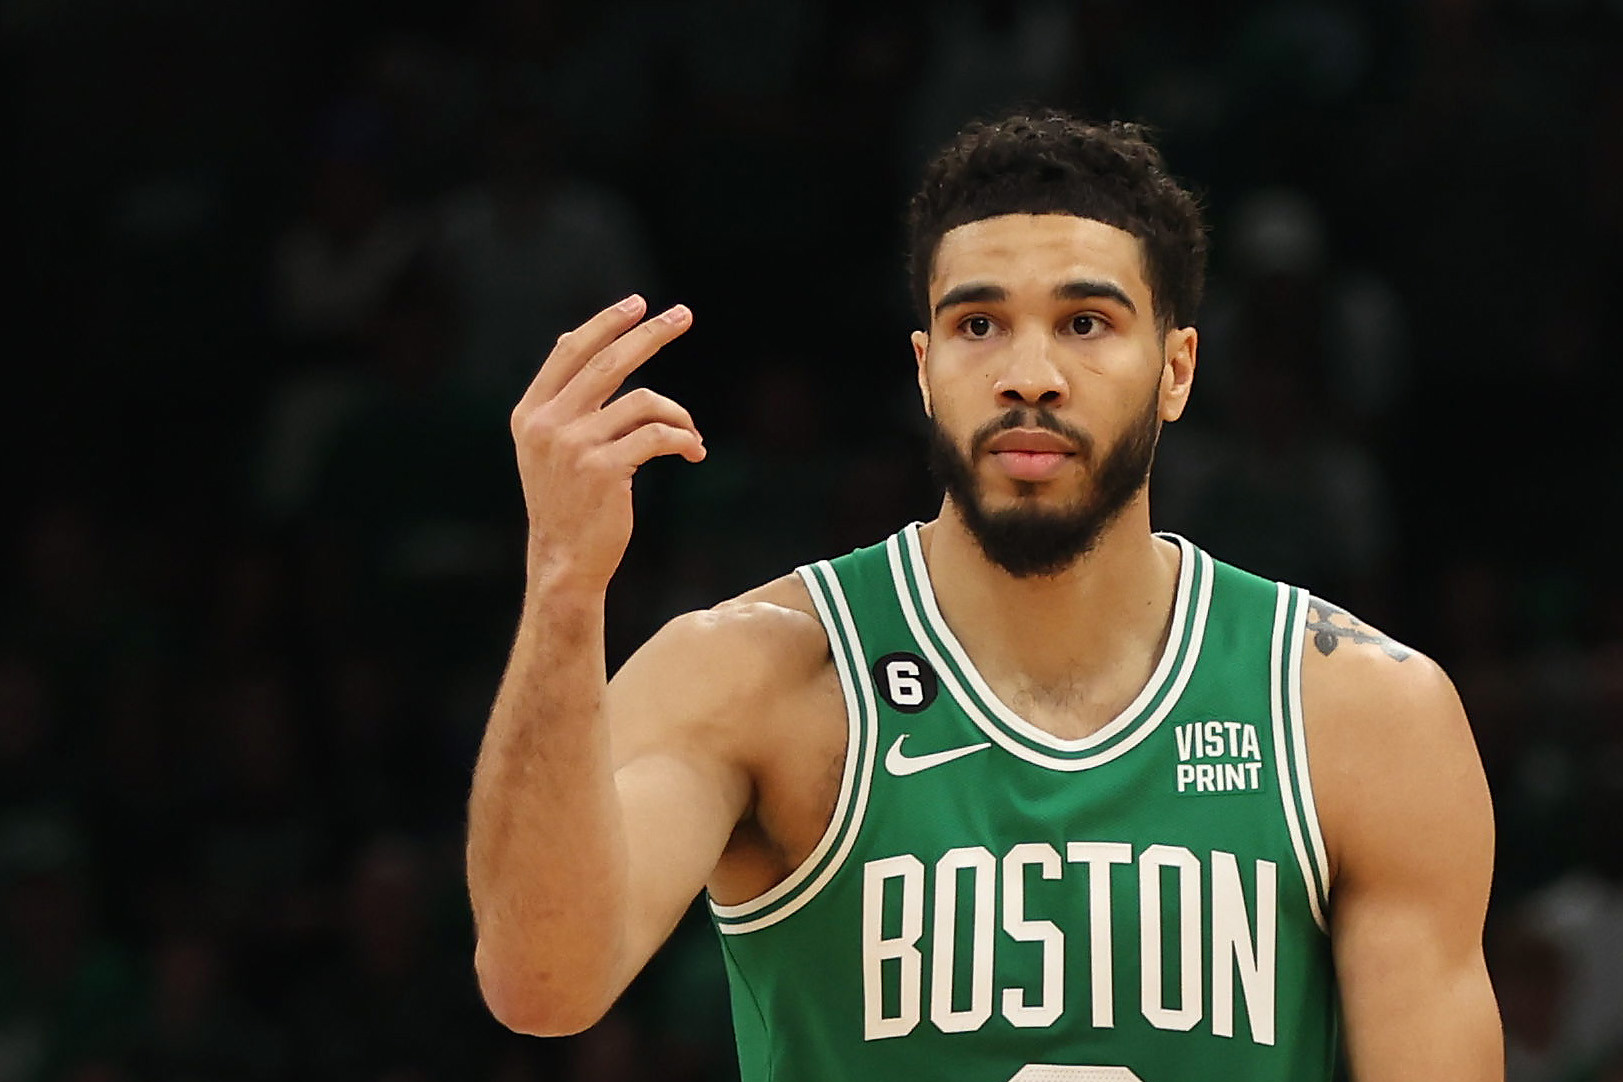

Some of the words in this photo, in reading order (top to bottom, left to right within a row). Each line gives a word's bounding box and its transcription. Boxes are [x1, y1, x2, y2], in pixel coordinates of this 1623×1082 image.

[886, 661, 924, 706] 6
[1175, 721, 1262, 762] VISTA
[1177, 762, 1262, 792] PRINT
[863, 842, 1278, 1047] BOSTON
